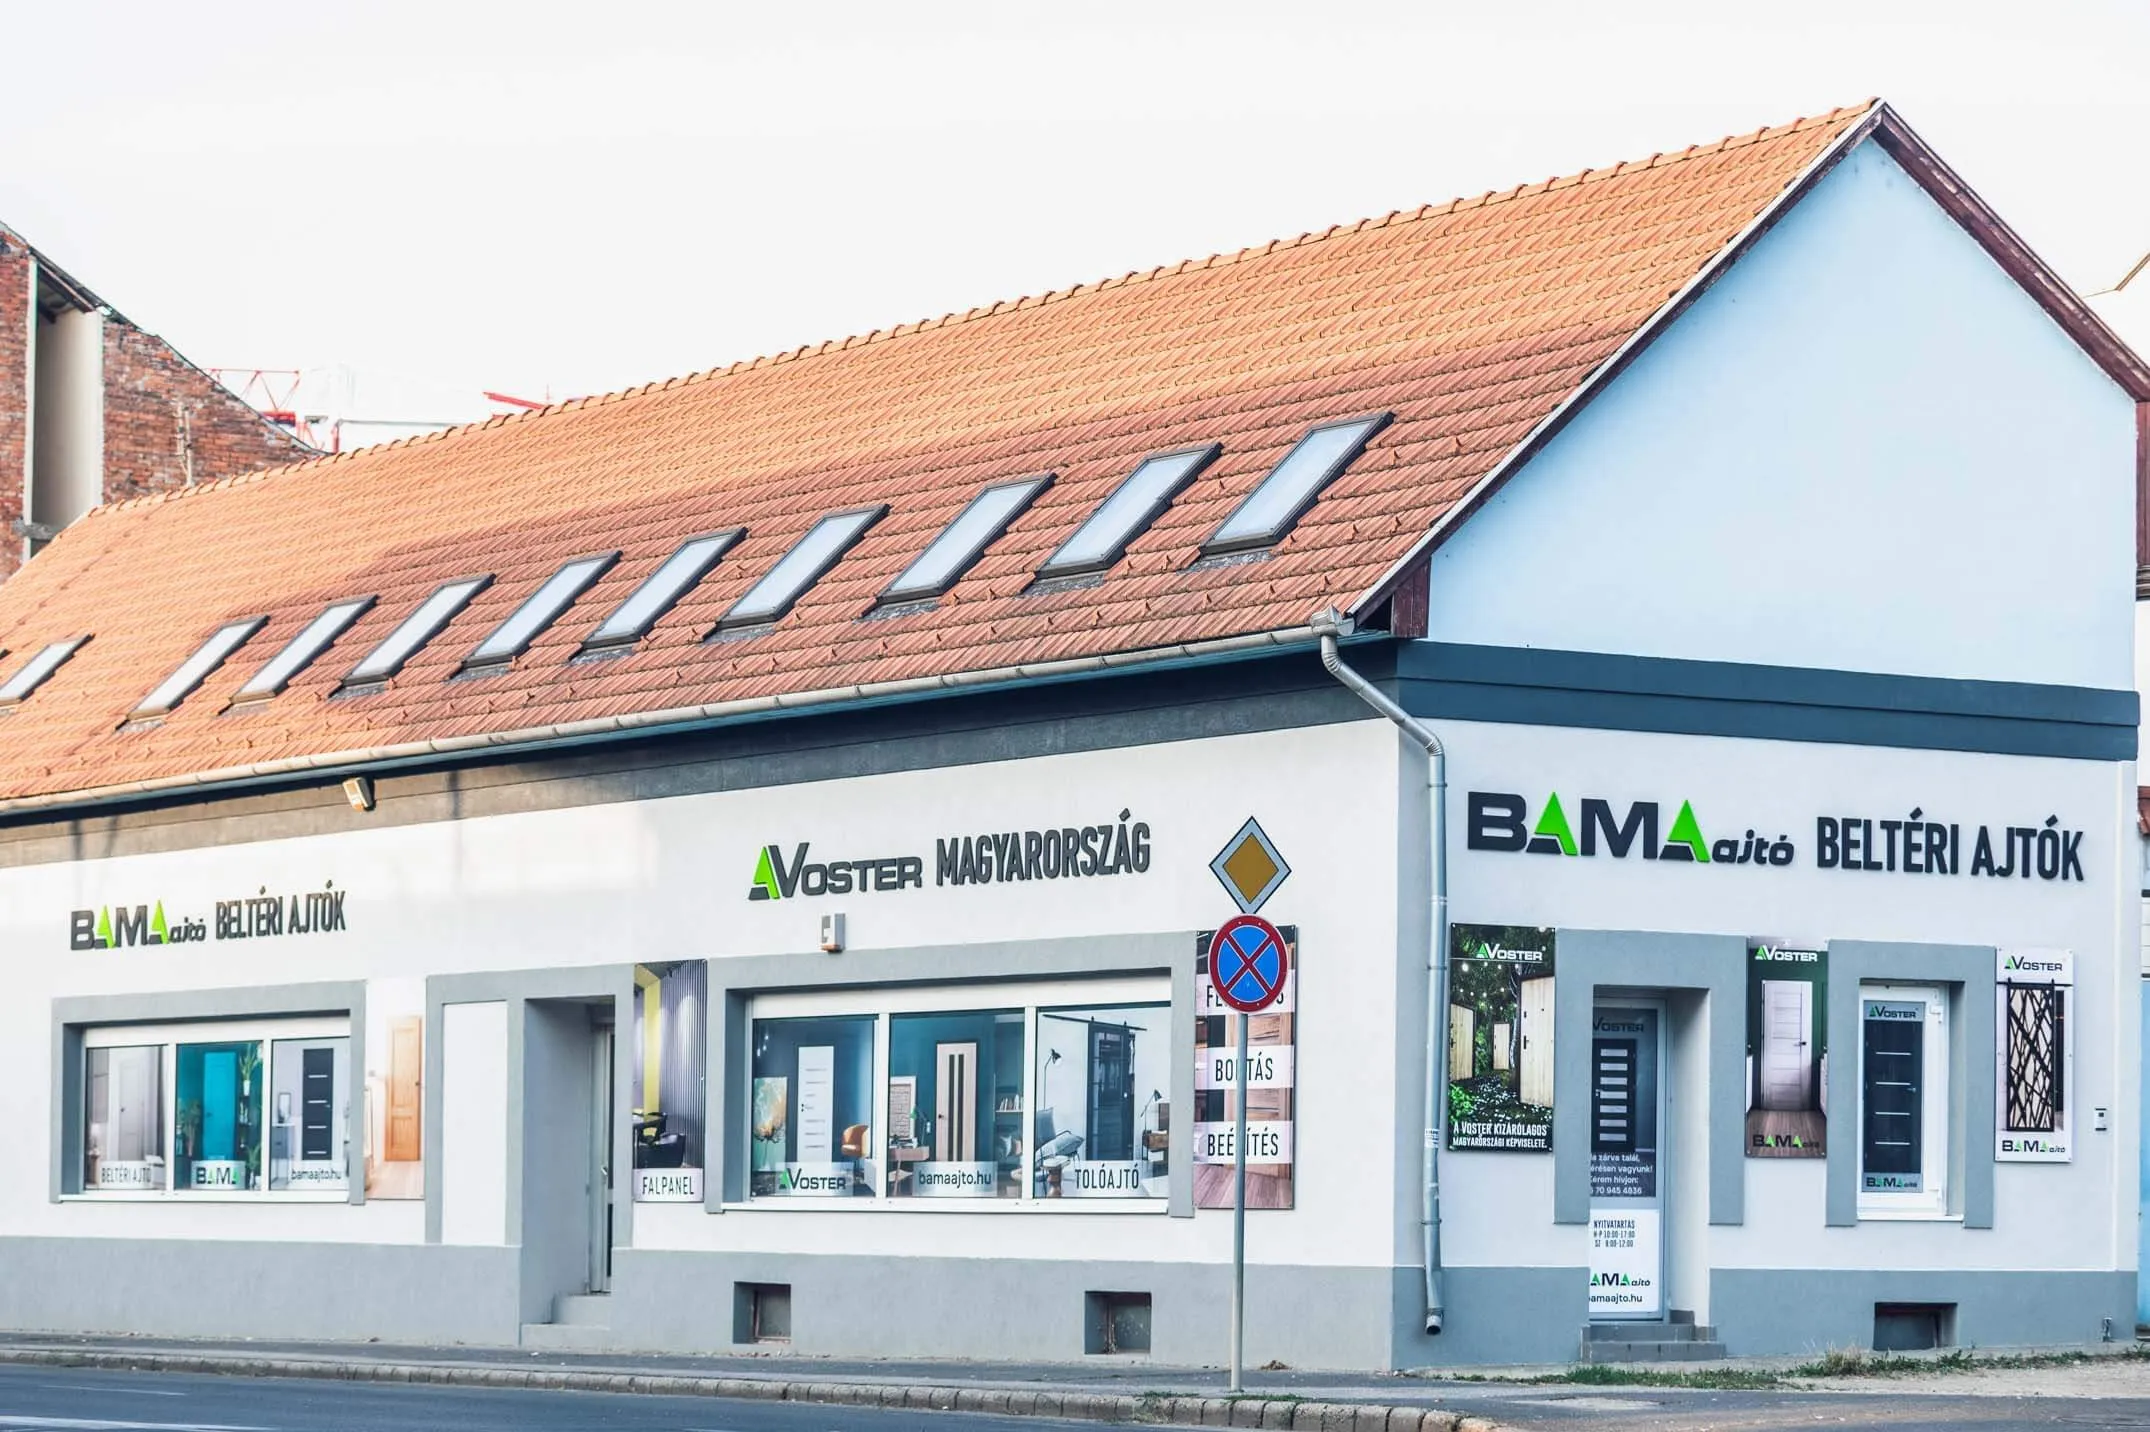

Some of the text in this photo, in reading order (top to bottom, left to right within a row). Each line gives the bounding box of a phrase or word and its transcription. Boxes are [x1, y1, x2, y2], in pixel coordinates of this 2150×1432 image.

[1467, 791, 2084, 881] BAMA ajtó BELTÉRI AJTÓK
[935, 808, 1151, 886] MAGYARORSZÁG
[70, 899, 169, 951] BAMA
[215, 886, 283, 940] BELTÉRI
[287, 880, 346, 934] AJTÓK
[1215, 1051, 1273, 1081] BOTÁS
[1453, 1121, 1459, 1135] A
[1461, 1121, 1493, 1135] VOSTER
[1207, 1127, 1279, 1157] BEÉÍTÉS
[1752, 1134, 1803, 1148] BAMA
[2001, 1139, 2049, 1153] BAMA
[1075, 1163, 1139, 1189] TOLÓAJTÓ
[1617, 1164, 1653, 1174] vagyunk!
[642, 1176, 695, 1195] FALPANEL
[918, 1170, 992, 1188] bamaajto.hu
[1590, 1272, 1630, 1286] AMA
[1588, 1293, 1643, 1304] amaajto.hu
